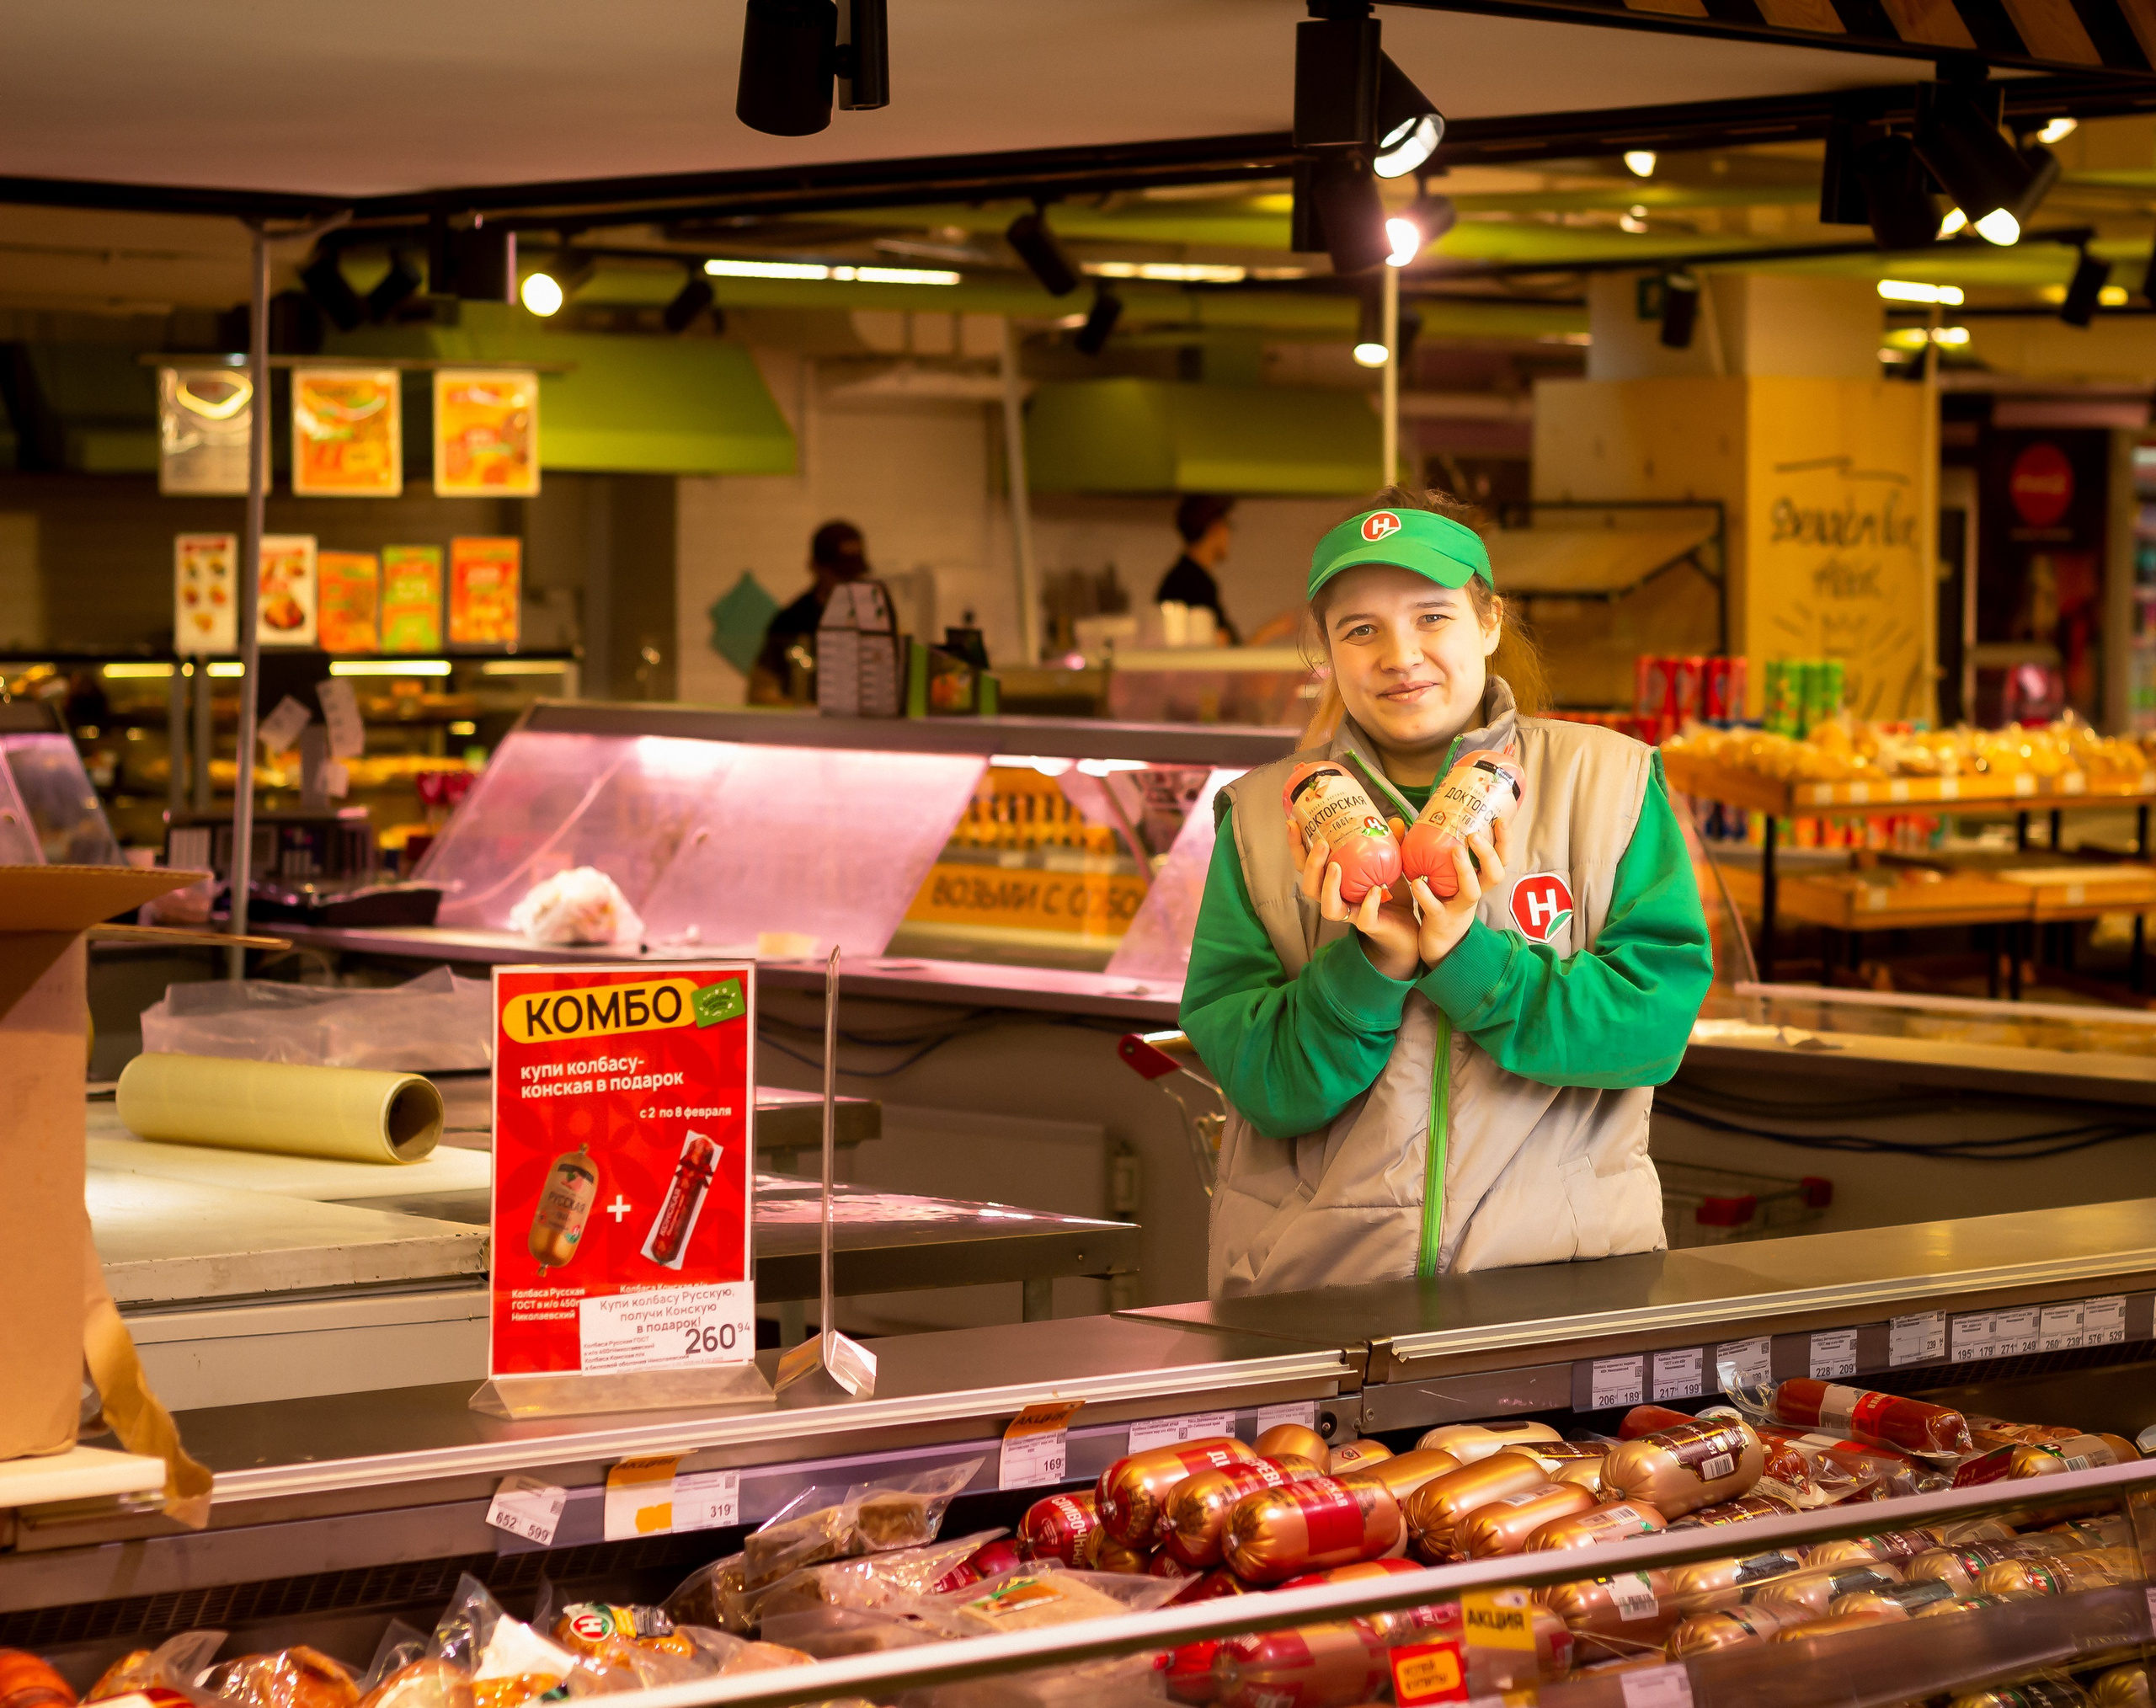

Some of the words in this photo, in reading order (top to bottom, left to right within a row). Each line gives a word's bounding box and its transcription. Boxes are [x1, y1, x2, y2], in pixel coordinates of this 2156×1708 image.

[1304, 795, 1368, 840] ДОКТОРСКАЯ
[1331, 817, 1350, 831] ГОСТ
[525, 985, 683, 1037] КОМБО
[520, 1063, 563, 1084] купи
[566, 1054, 645, 1076] колбасу-
[520, 1077, 593, 1099] конская
[596, 1080, 607, 1092] в
[610, 1071, 684, 1091] подарок
[639, 1110, 647, 1118] с
[648, 1108, 656, 1118] 2
[659, 1108, 674, 1118] по
[675, 1106, 682, 1118] 8
[683, 1106, 732, 1120] февраля
[511, 1288, 549, 1299] Колбаса
[549, 1287, 586, 1300] Русская
[600, 1300, 629, 1312] Купи
[632, 1293, 679, 1306] колбасу
[682, 1288, 735, 1302] Русскую,
[511, 1300, 536, 1310] ГОСТ
[511, 1310, 576, 1321] Николаевский
[620, 1310, 664, 1322] получи
[664, 1303, 717, 1316] Конскую
[636, 1325, 643, 1334] в
[646, 1316, 702, 1333] подарок!
[684, 1323, 737, 1355] 260
[737, 1322, 750, 1333] 94
[2066, 1337, 2080, 1348] 239
[2088, 1333, 2102, 1344] 576
[2109, 1330, 2122, 1342] 529
[2000, 1343, 2015, 1354] 271
[2022, 1340, 2036, 1353] 249
[2045, 1339, 2059, 1349] 260
[1957, 1348, 1972, 1360] 195
[1979, 1346, 1993, 1358] 179
[1816, 1366, 1831, 1378] 228
[1839, 1364, 1854, 1374] 209
[1659, 1386, 1675, 1399] 217
[1684, 1383, 1700, 1396] 199
[1598, 1395, 1615, 1406] 206
[1624, 1390, 1640, 1404] 189
[1043, 1457, 1062, 1471] 169
[710, 1503, 731, 1518] 319
[495, 1511, 517, 1530] 652
[527, 1524, 550, 1542] 599
[1467, 1608, 1525, 1631] АКЦИЯ
